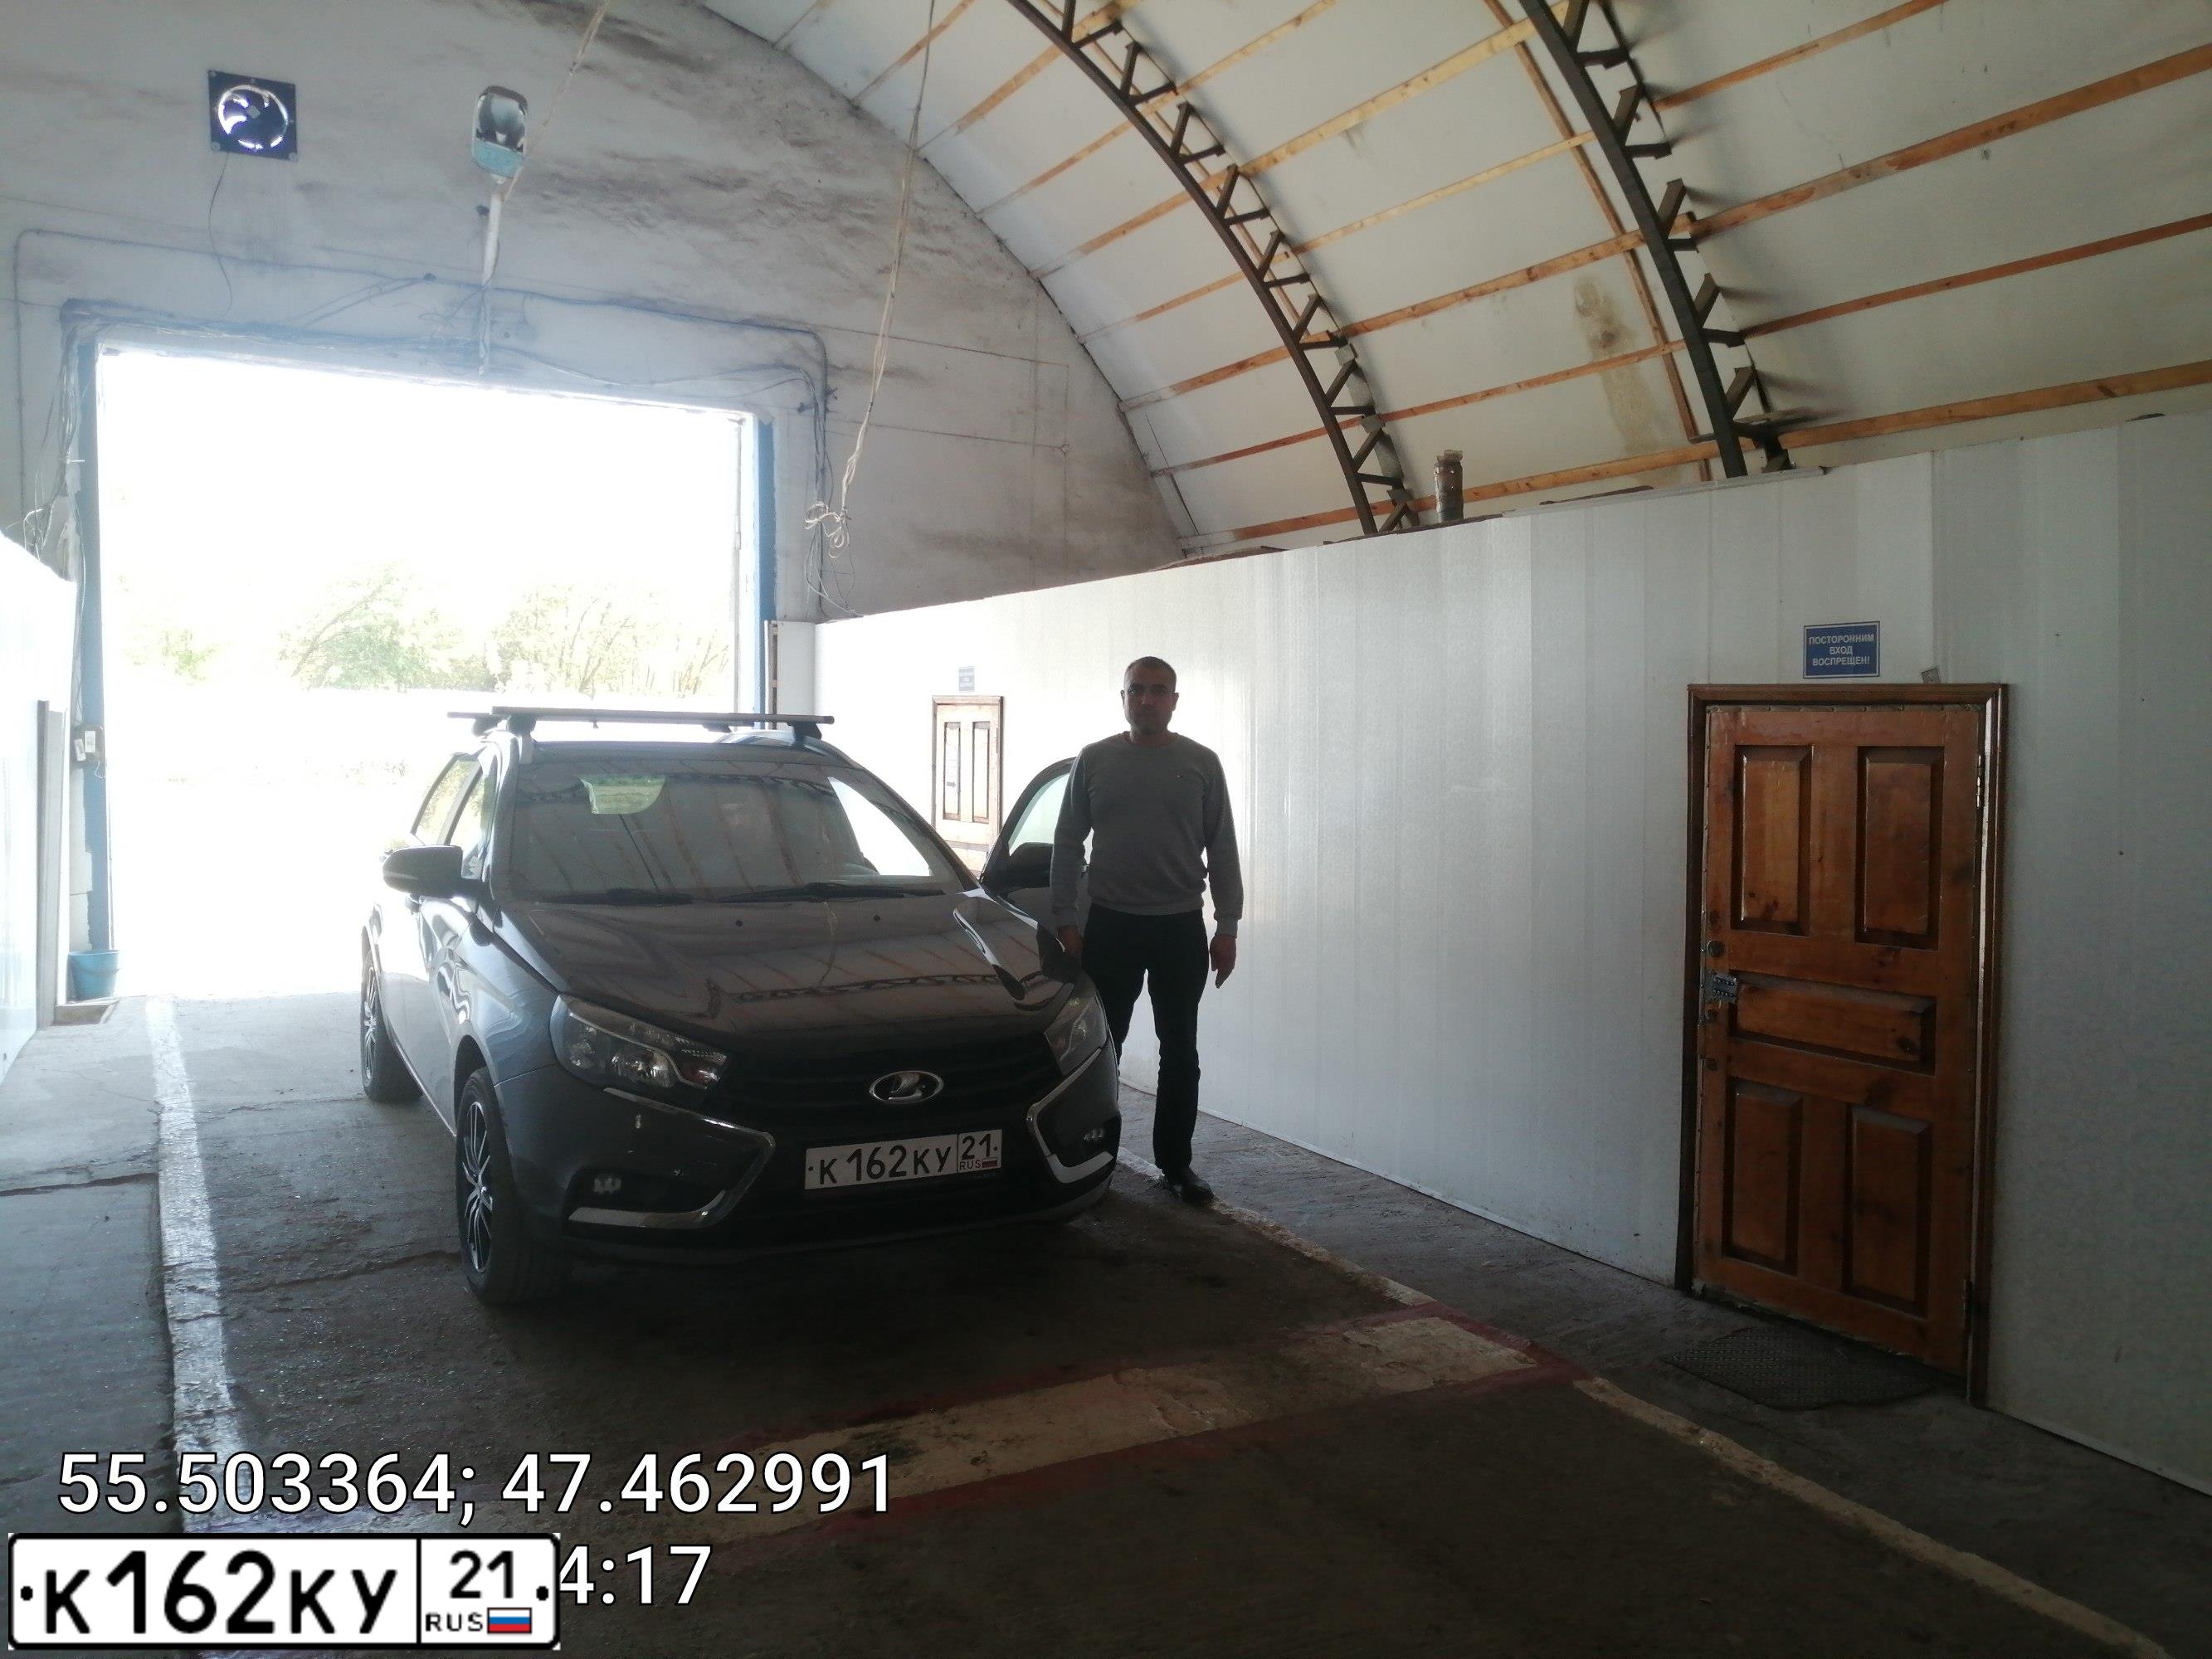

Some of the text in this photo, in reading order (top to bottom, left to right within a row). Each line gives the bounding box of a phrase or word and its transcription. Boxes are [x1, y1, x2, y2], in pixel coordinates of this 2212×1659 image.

[1809, 634, 1874, 645] ПОСТОРОННИМ
[1830, 646, 1853, 655] ВХОД
[1812, 656, 1870, 666] ВОСПРЕЩЕН!
[962, 1134, 992, 1160] 21
[959, 1160, 982, 1171] RUS
